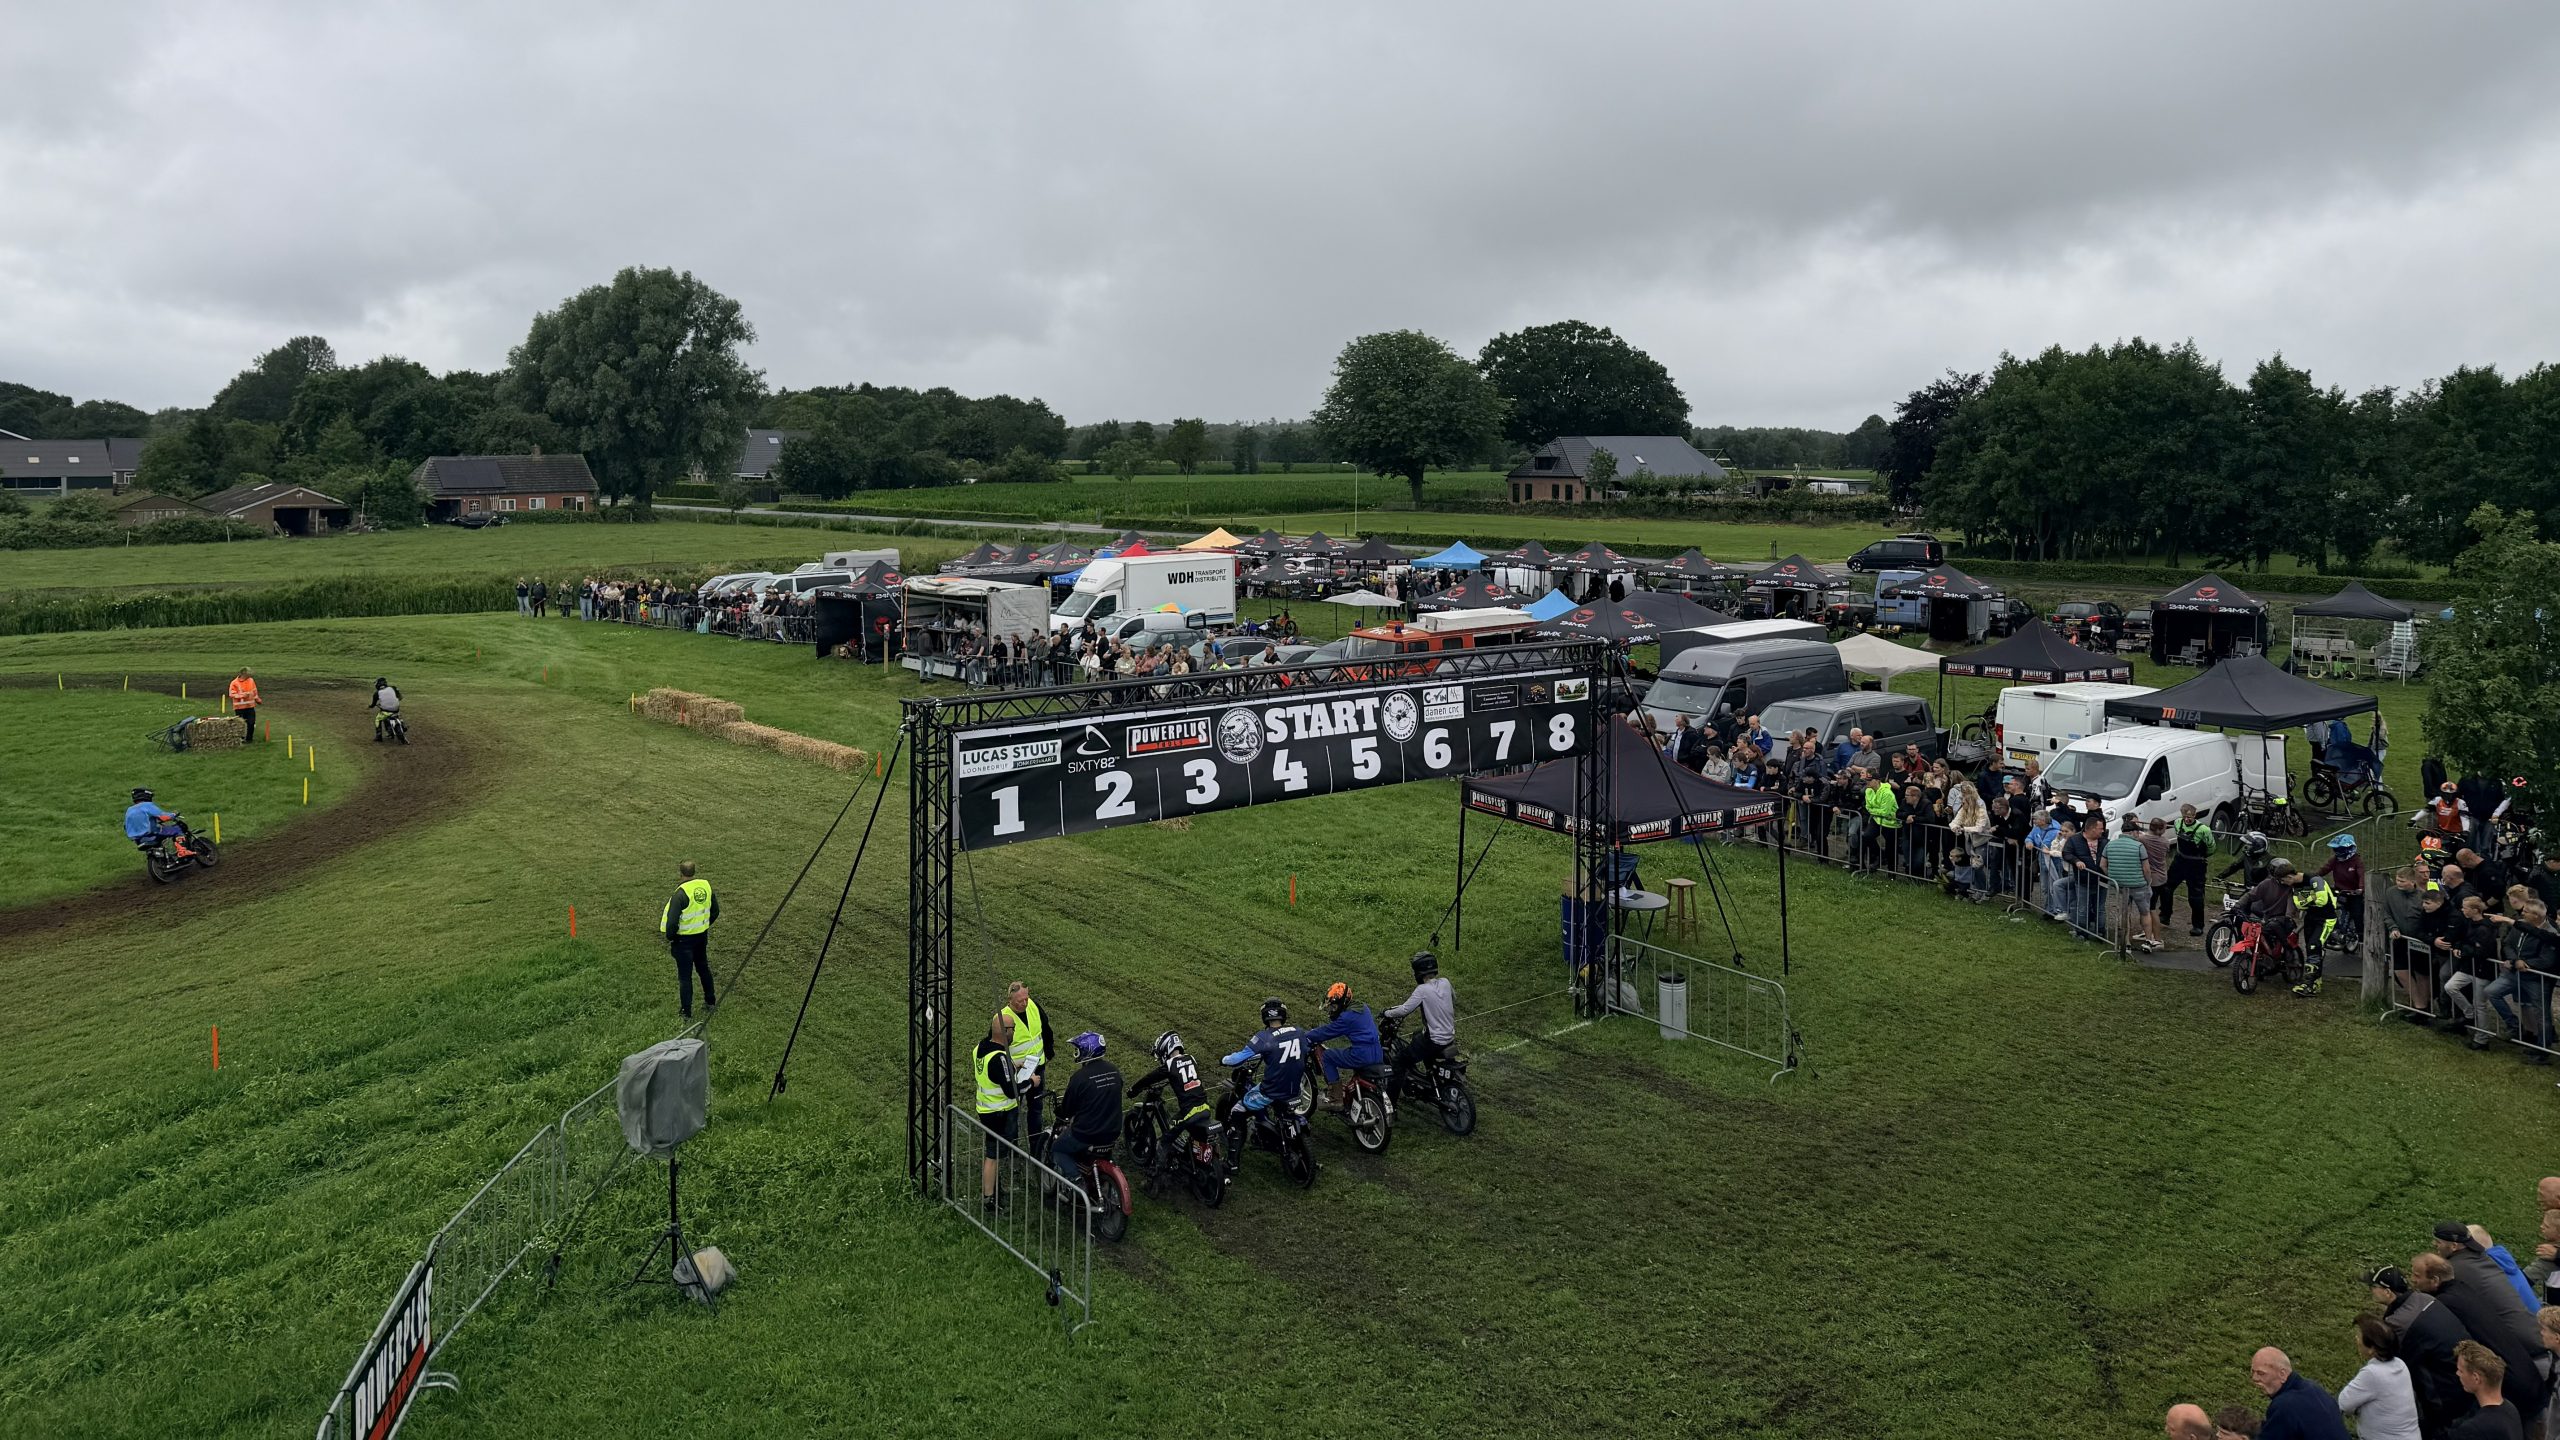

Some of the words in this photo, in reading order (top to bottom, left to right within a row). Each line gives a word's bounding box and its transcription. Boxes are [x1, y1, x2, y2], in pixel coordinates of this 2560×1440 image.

[1167, 571, 1194, 585] WDH
[1195, 568, 1227, 576] TRANSPORT
[1942, 592, 1970, 600] 24MX
[2168, 603, 2200, 611] 24MX
[2218, 606, 2251, 615] 24MX
[1264, 696, 1380, 744] START
[1425, 707, 1447, 717] damen
[1132, 720, 1207, 752] POWERPLUS
[1490, 720, 1516, 761] 7
[1549, 712, 1576, 751] 8
[963, 748, 1009, 766] LUCAS
[1012, 742, 1058, 759] STUUT
[1350, 736, 1382, 780] 5
[1423, 727, 1452, 769] 6
[962, 763, 1009, 775] LOONBEDRIJF
[1068, 758, 1116, 774] SIXTY82
[1272, 748, 1308, 792] 4
[1095, 770, 1136, 820] 2
[1183, 758, 1221, 805] 3
[991, 785, 1025, 836] 1
[1279, 1038, 1301, 1064] 74
[1179, 1063, 1198, 1084] 14
[1438, 1067, 1451, 1079] 38
[355, 1267, 433, 1440] POWERPLUS
